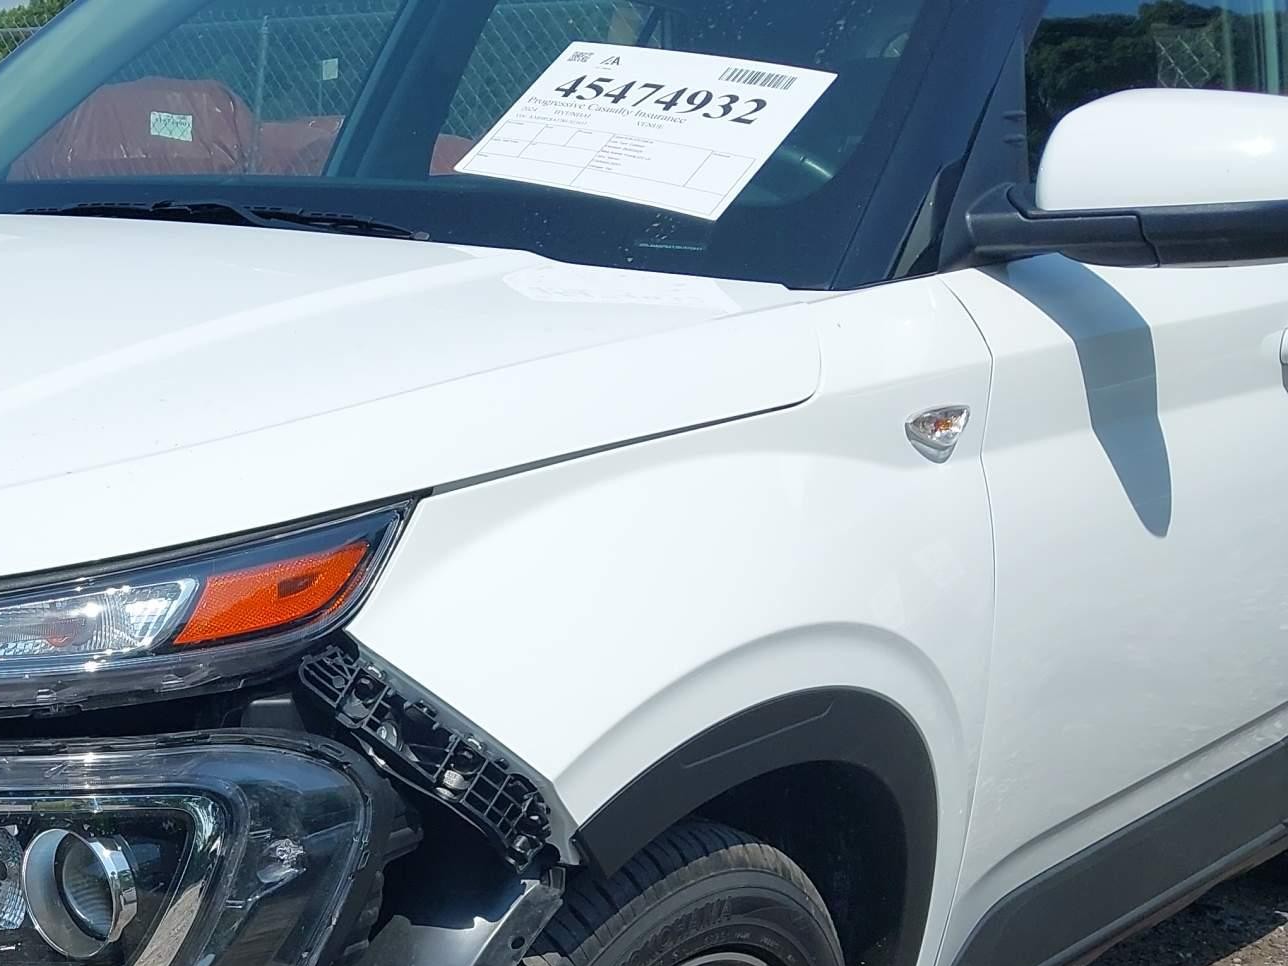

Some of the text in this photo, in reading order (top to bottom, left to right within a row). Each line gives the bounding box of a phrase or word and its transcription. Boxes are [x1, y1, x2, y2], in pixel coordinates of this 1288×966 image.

[527, 96, 688, 124] Progressive Casualty Insurance
[554, 75, 767, 125] 45474932
